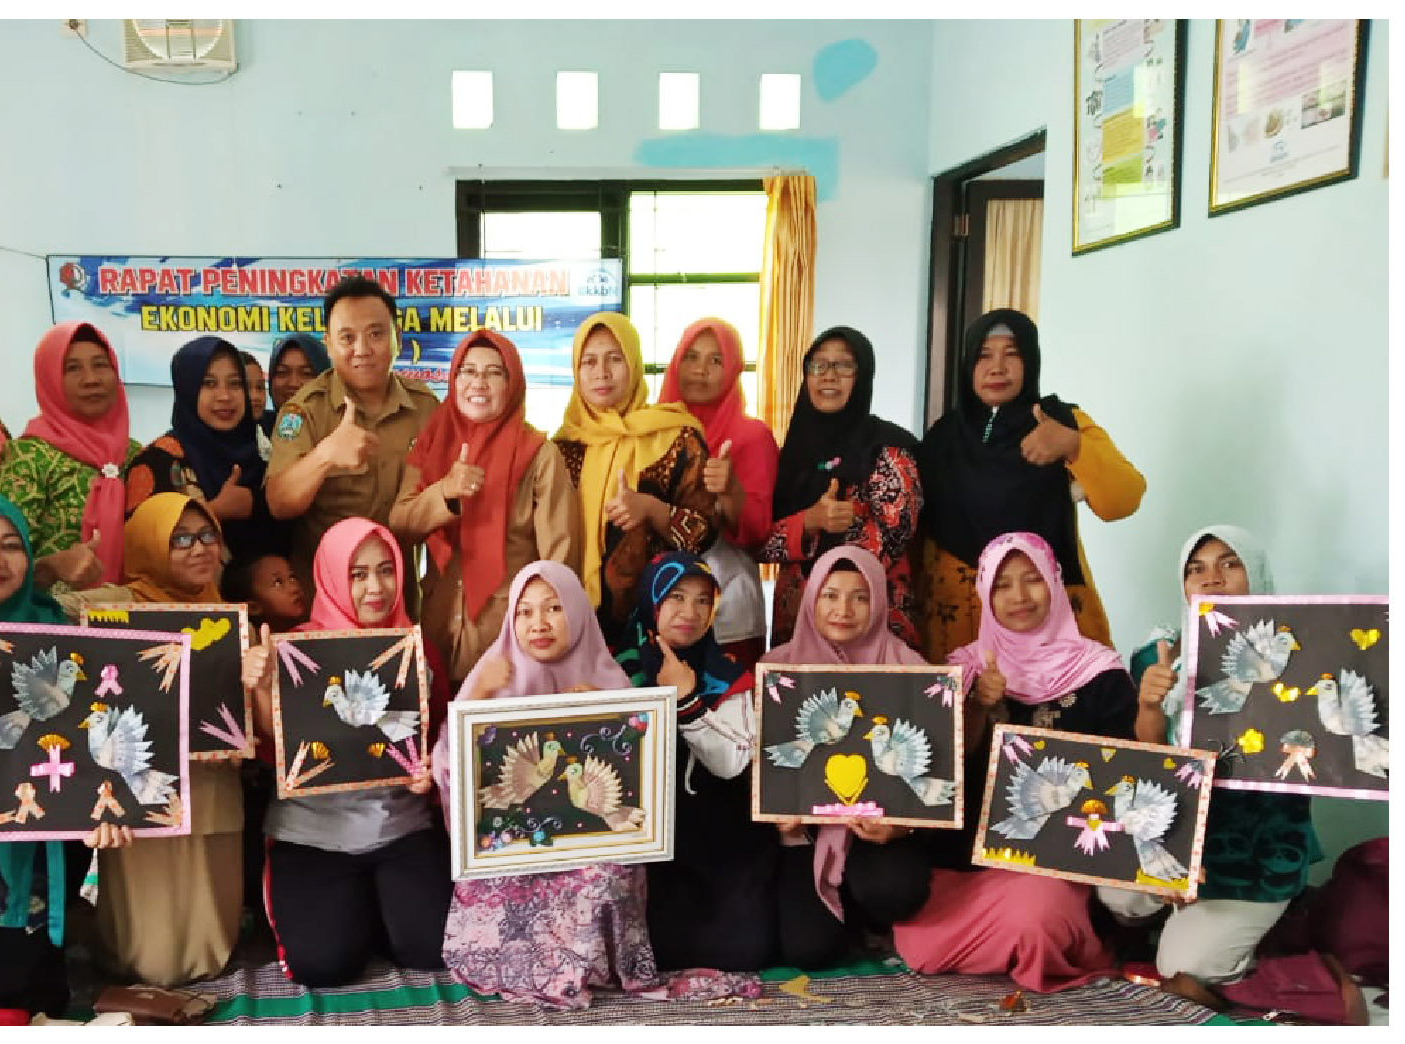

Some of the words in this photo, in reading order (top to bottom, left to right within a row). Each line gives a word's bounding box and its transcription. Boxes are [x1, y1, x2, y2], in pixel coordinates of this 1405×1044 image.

[97, 266, 195, 295] RAPAT
[404, 267, 571, 297] KETAHANAN
[141, 305, 270, 332] EKONOMI
[428, 306, 543, 333] MELALUI
